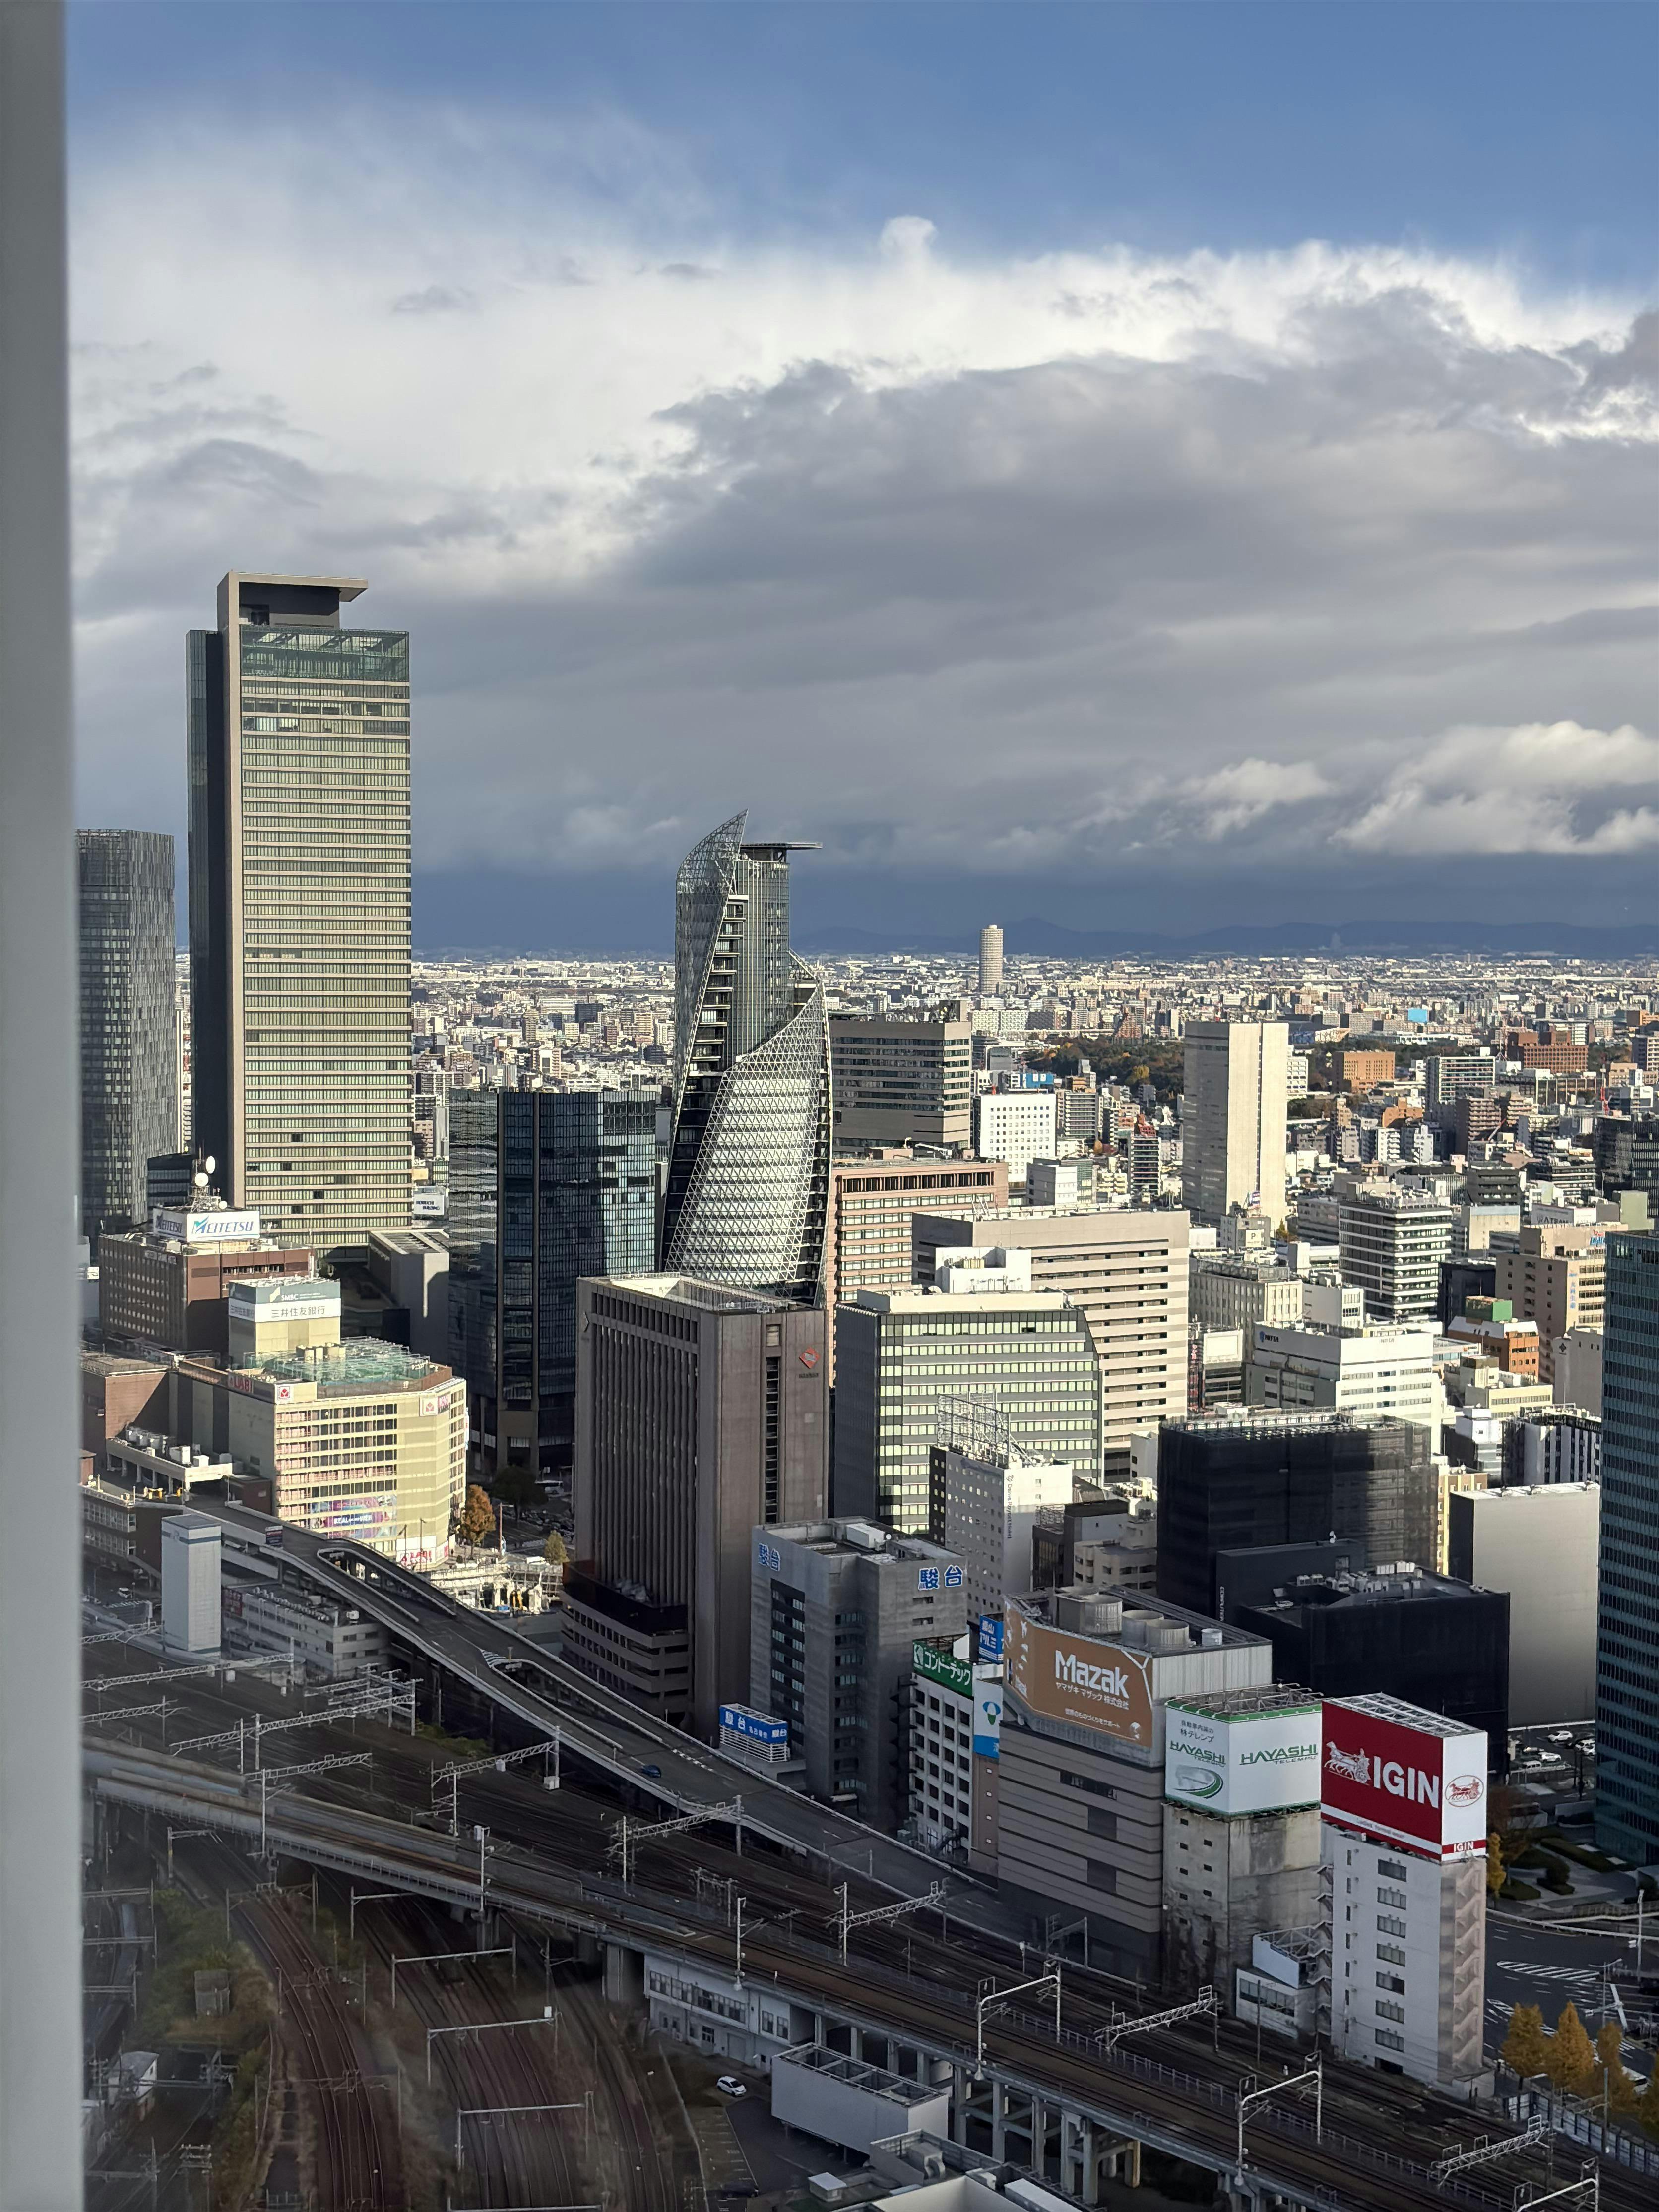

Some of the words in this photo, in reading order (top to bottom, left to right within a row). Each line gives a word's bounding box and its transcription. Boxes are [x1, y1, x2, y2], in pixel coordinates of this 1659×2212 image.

[191, 1215, 254, 1234] MEITETSU
[271, 1305, 325, 1318] 三井住友銀行
[758, 1543, 781, 1571] 駿台
[918, 1565, 963, 1591] 駿台
[924, 1650, 971, 1685] コンドーテック
[1055, 1650, 1129, 1699] Mazak
[1181, 1729, 1214, 1743] 林テレンプ
[1170, 1740, 1225, 1765] HAYASHI
[1240, 1744, 1317, 1764] HAYASHI
[1274, 1756, 1316, 1764] TELEMPU
[1373, 1756, 1439, 1809] IGIN
[1454, 1841, 1474, 1852] IGIN
